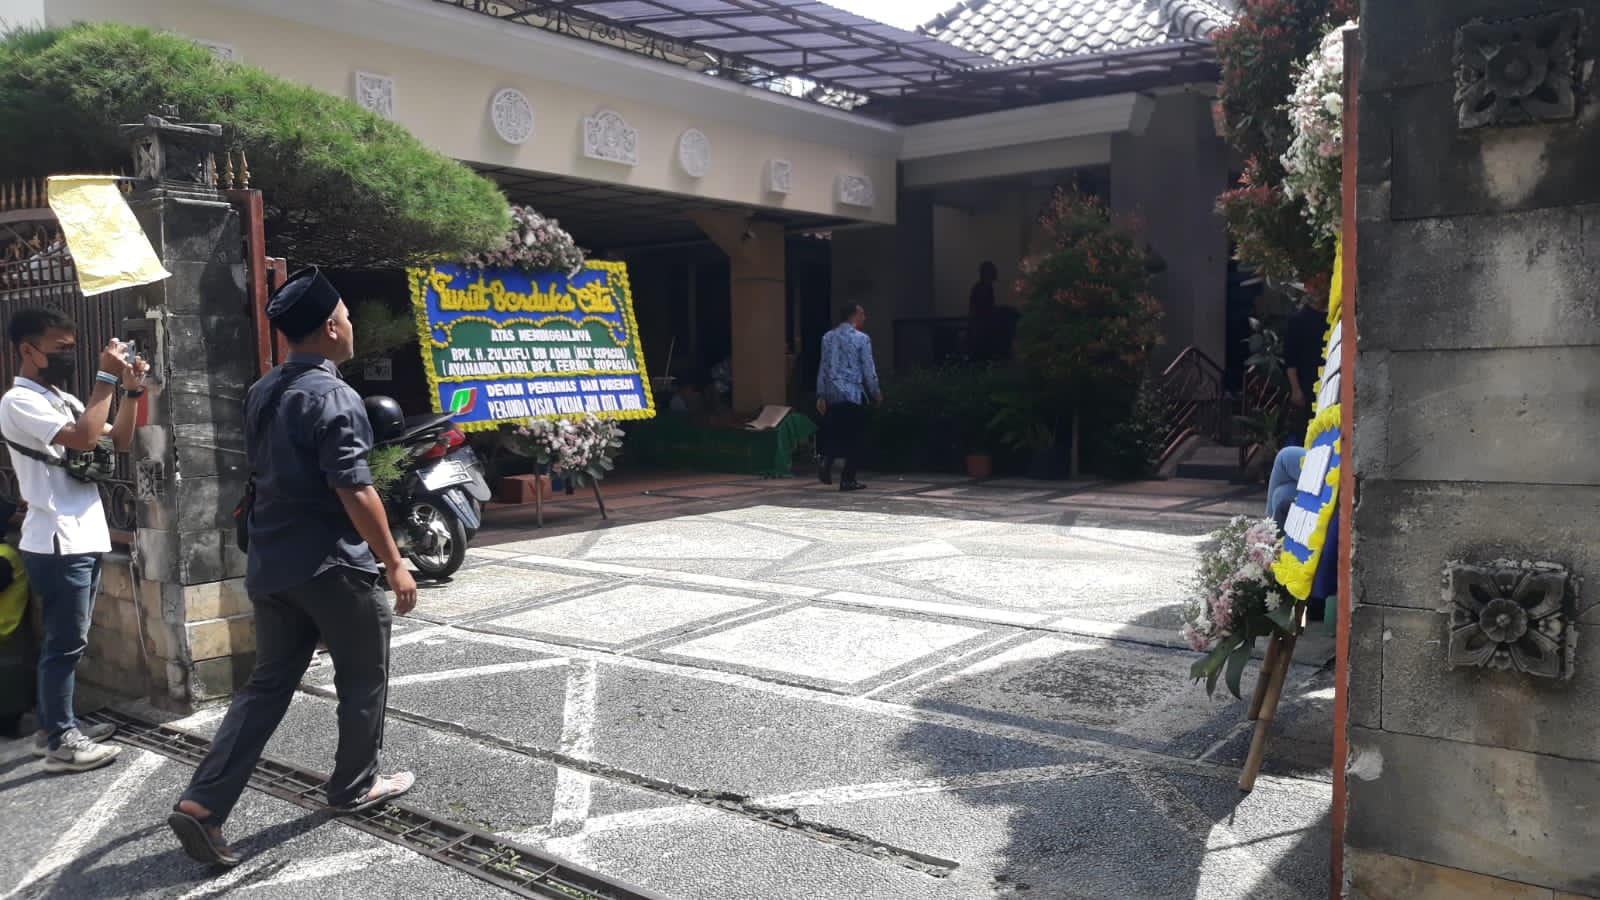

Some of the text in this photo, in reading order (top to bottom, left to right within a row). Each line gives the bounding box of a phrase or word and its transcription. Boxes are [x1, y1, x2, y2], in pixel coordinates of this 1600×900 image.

[491, 329, 515, 341] ATAS
[451, 348, 475, 361] BPK.
[487, 347, 530, 360] ZULKIFLI
[502, 361, 528, 374] DARI
[486, 383, 524, 397] DEWAN
[527, 380, 577, 395] PENGAWAS
[580, 379, 600, 392] DAN
